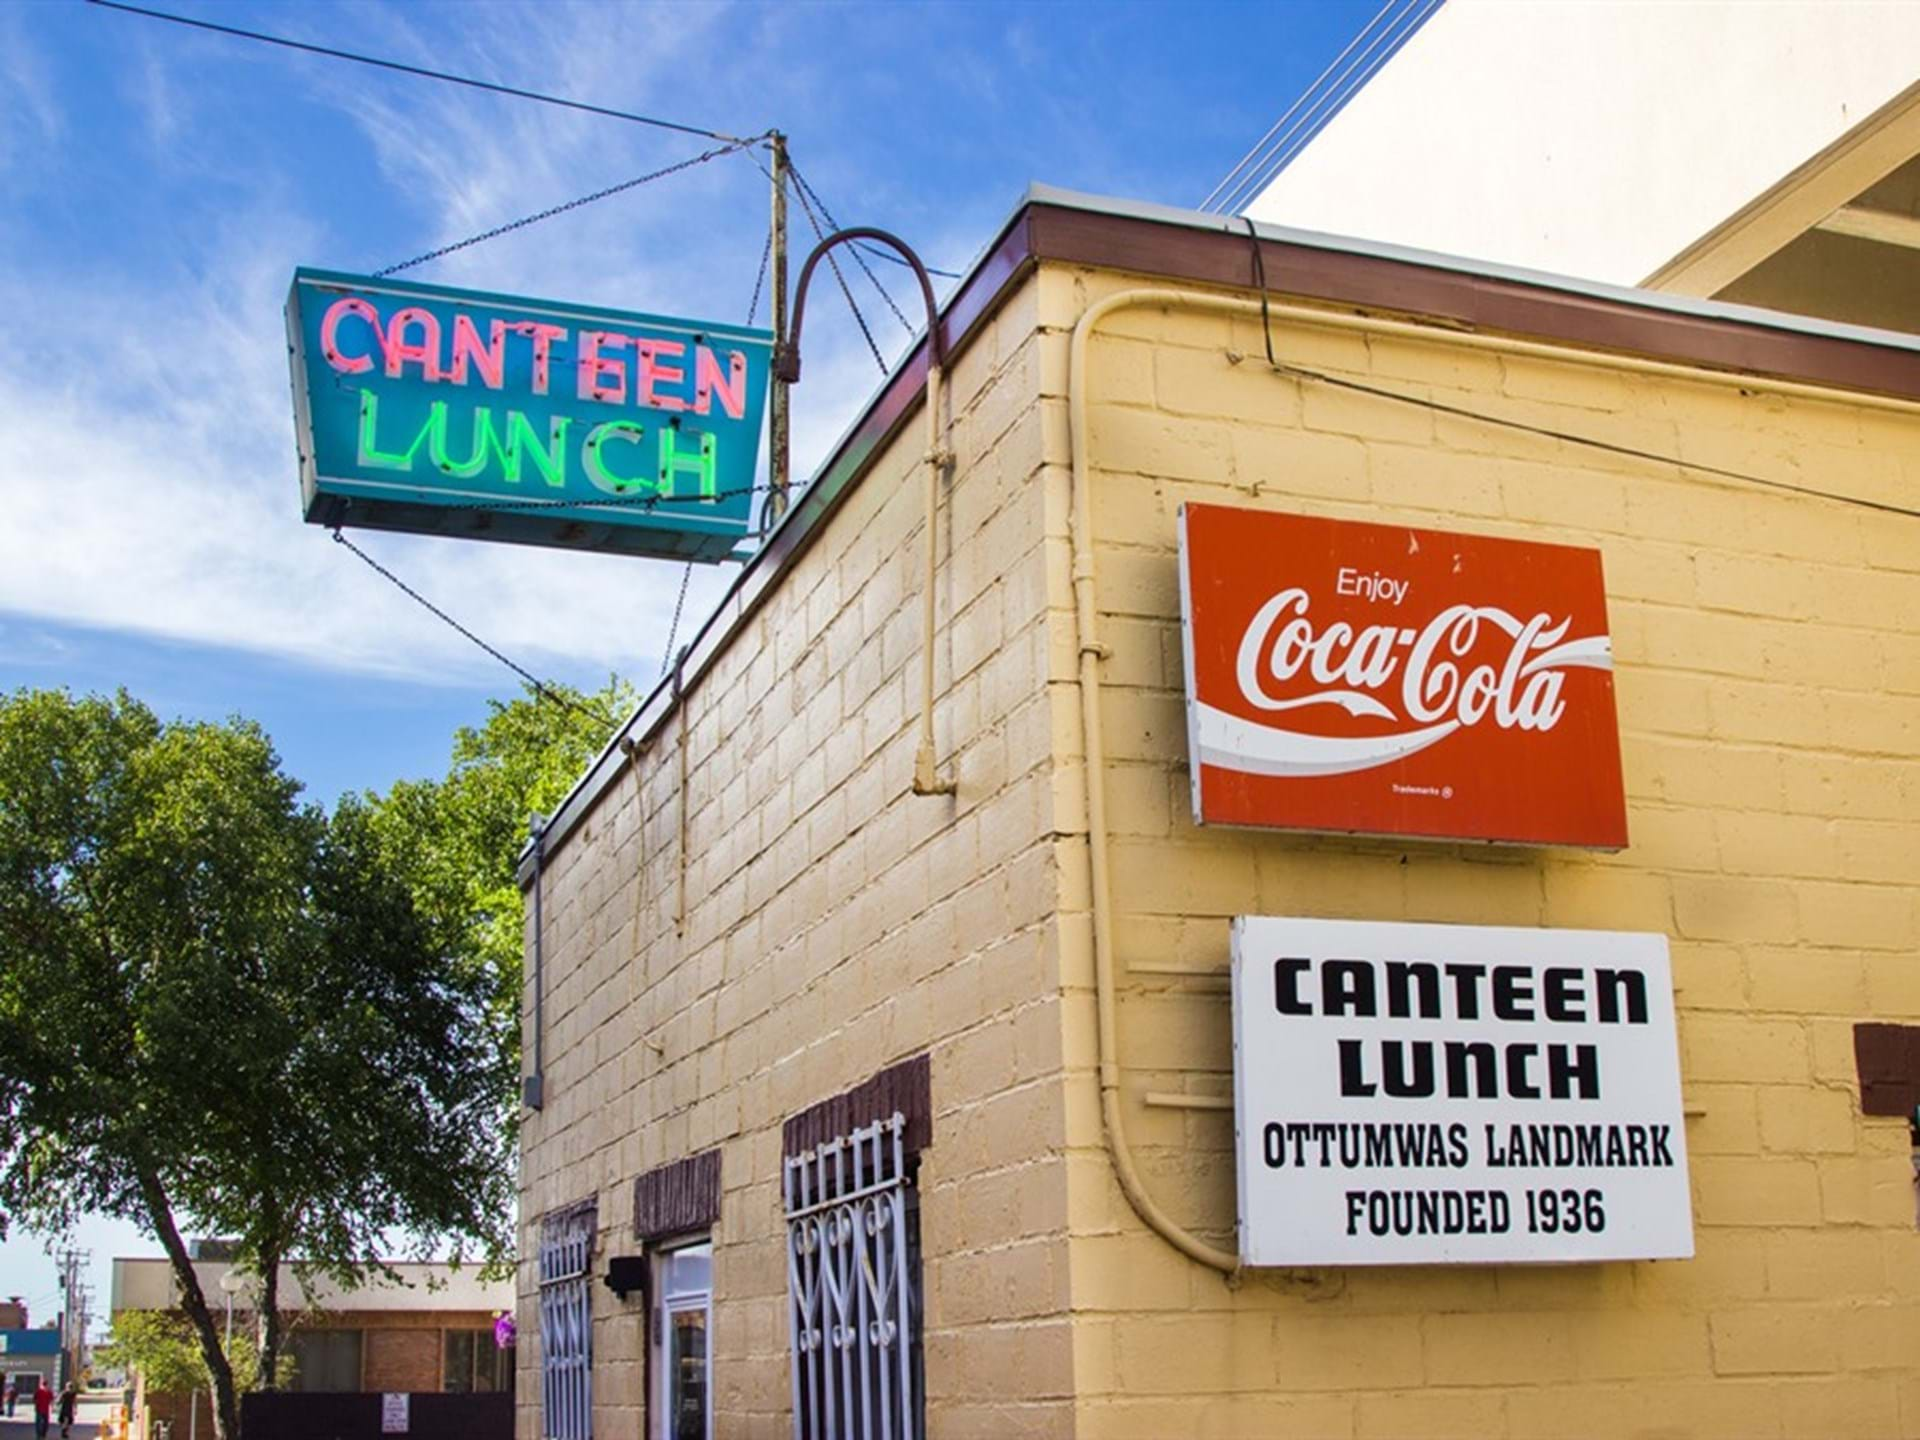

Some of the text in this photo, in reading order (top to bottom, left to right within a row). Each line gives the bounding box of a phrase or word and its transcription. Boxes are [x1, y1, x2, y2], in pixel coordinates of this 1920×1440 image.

[319, 298, 747, 419] CANTEEN
[357, 388, 717, 504] LUNCH
[1336, 567, 1409, 606] Enjoy
[1236, 588, 1573, 731] Coca-Cola
[1274, 957, 1649, 1025] CANTEEN
[1337, 1039, 1600, 1100] LUNCH
[1263, 1122, 1674, 1169] OTTUMWAS LANDMARK
[1345, 1189, 1606, 1237] FOUNDED 1936
